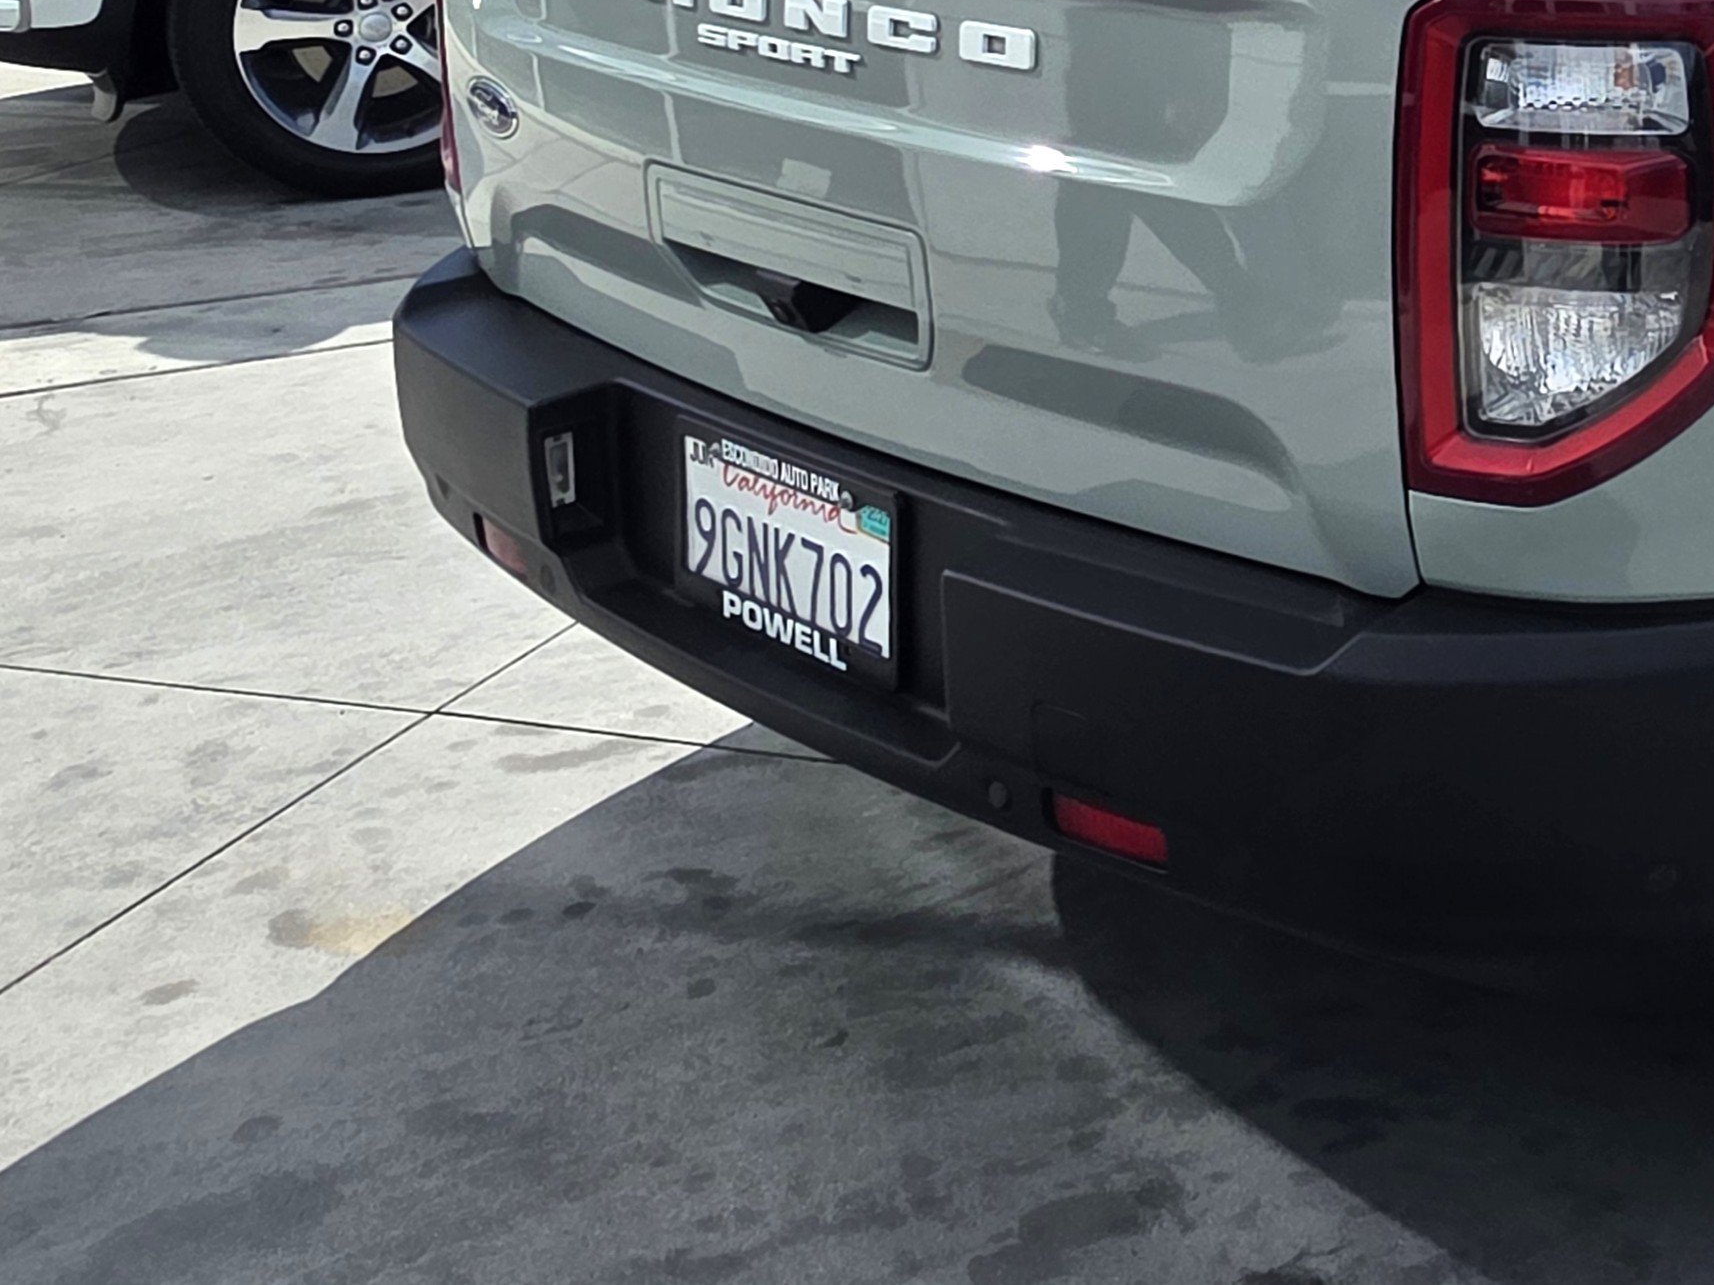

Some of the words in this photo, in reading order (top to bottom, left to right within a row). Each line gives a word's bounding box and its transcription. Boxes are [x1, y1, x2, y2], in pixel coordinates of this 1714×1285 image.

[697, 23, 862, 74] SPORT
[780, 462, 809, 490] AUTO
[810, 473, 840, 502] PARK
[694, 497, 883, 658] 9GNK702
[722, 590, 848, 671] POWELL
